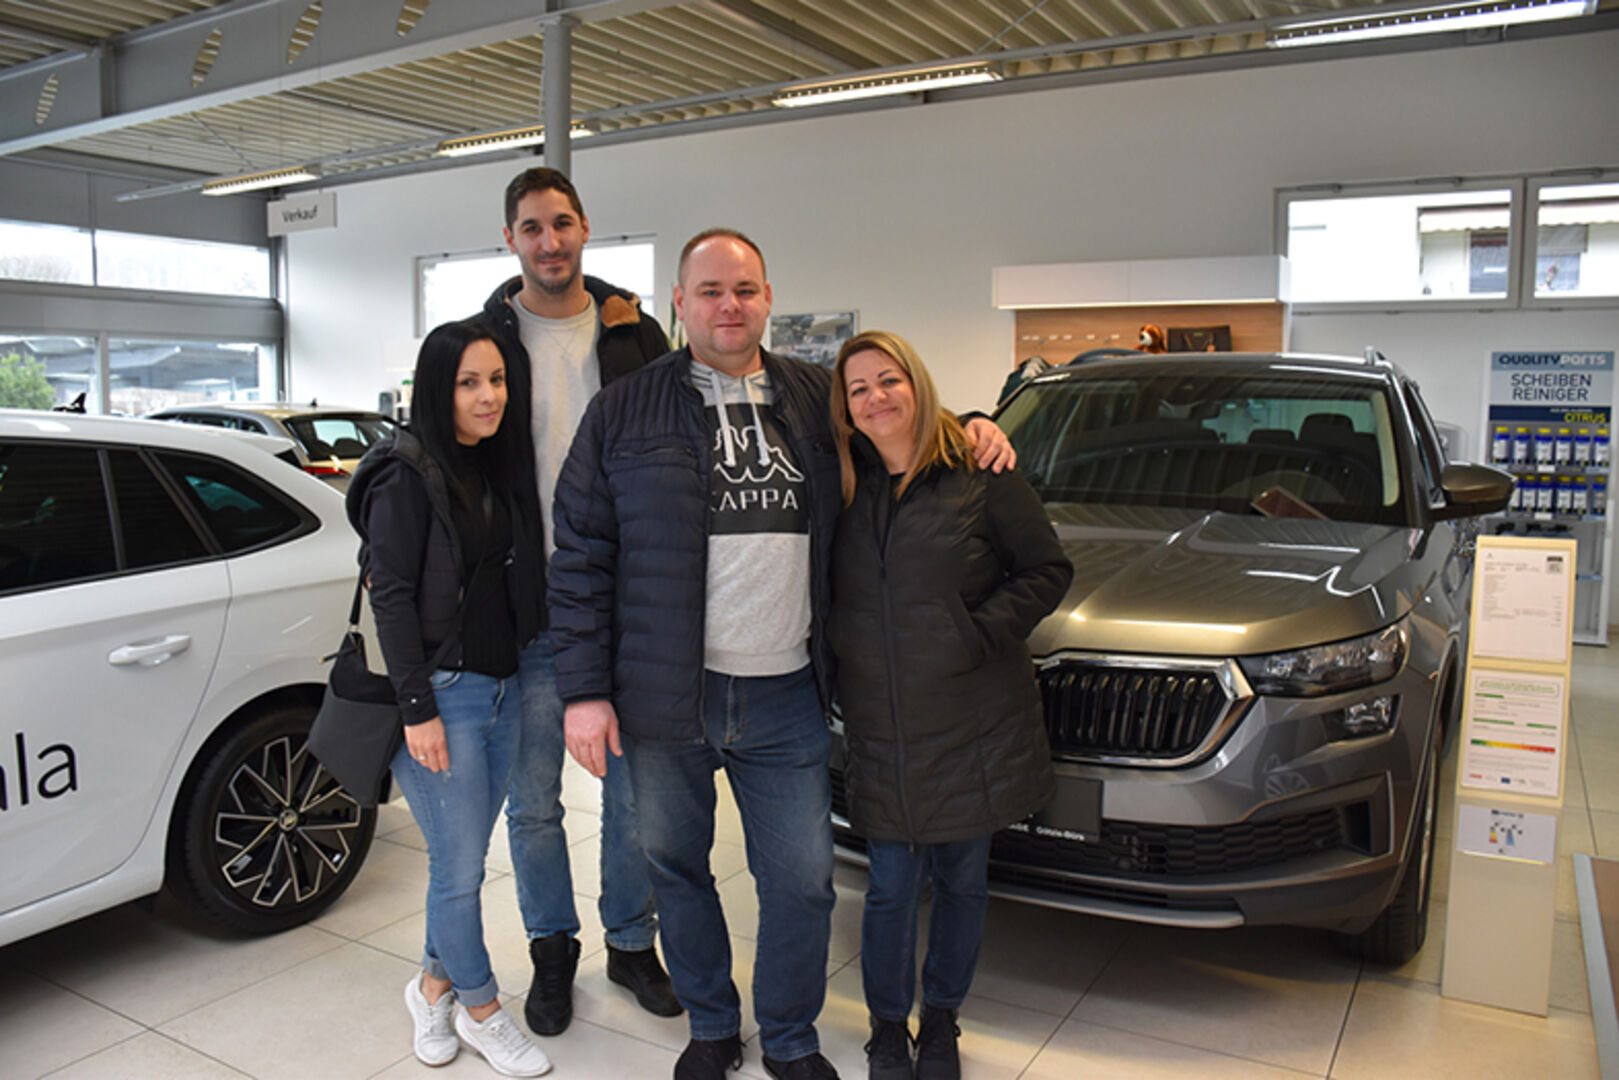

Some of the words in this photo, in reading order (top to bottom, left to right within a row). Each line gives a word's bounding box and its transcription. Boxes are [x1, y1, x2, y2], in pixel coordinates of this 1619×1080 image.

[281, 205, 318, 223] Verkauf
[1511, 373, 1592, 387] SCHEIBEN
[1513, 387, 1588, 401] REINIGER
[1564, 412, 1606, 424] CITRUS
[0, 731, 77, 811] la
